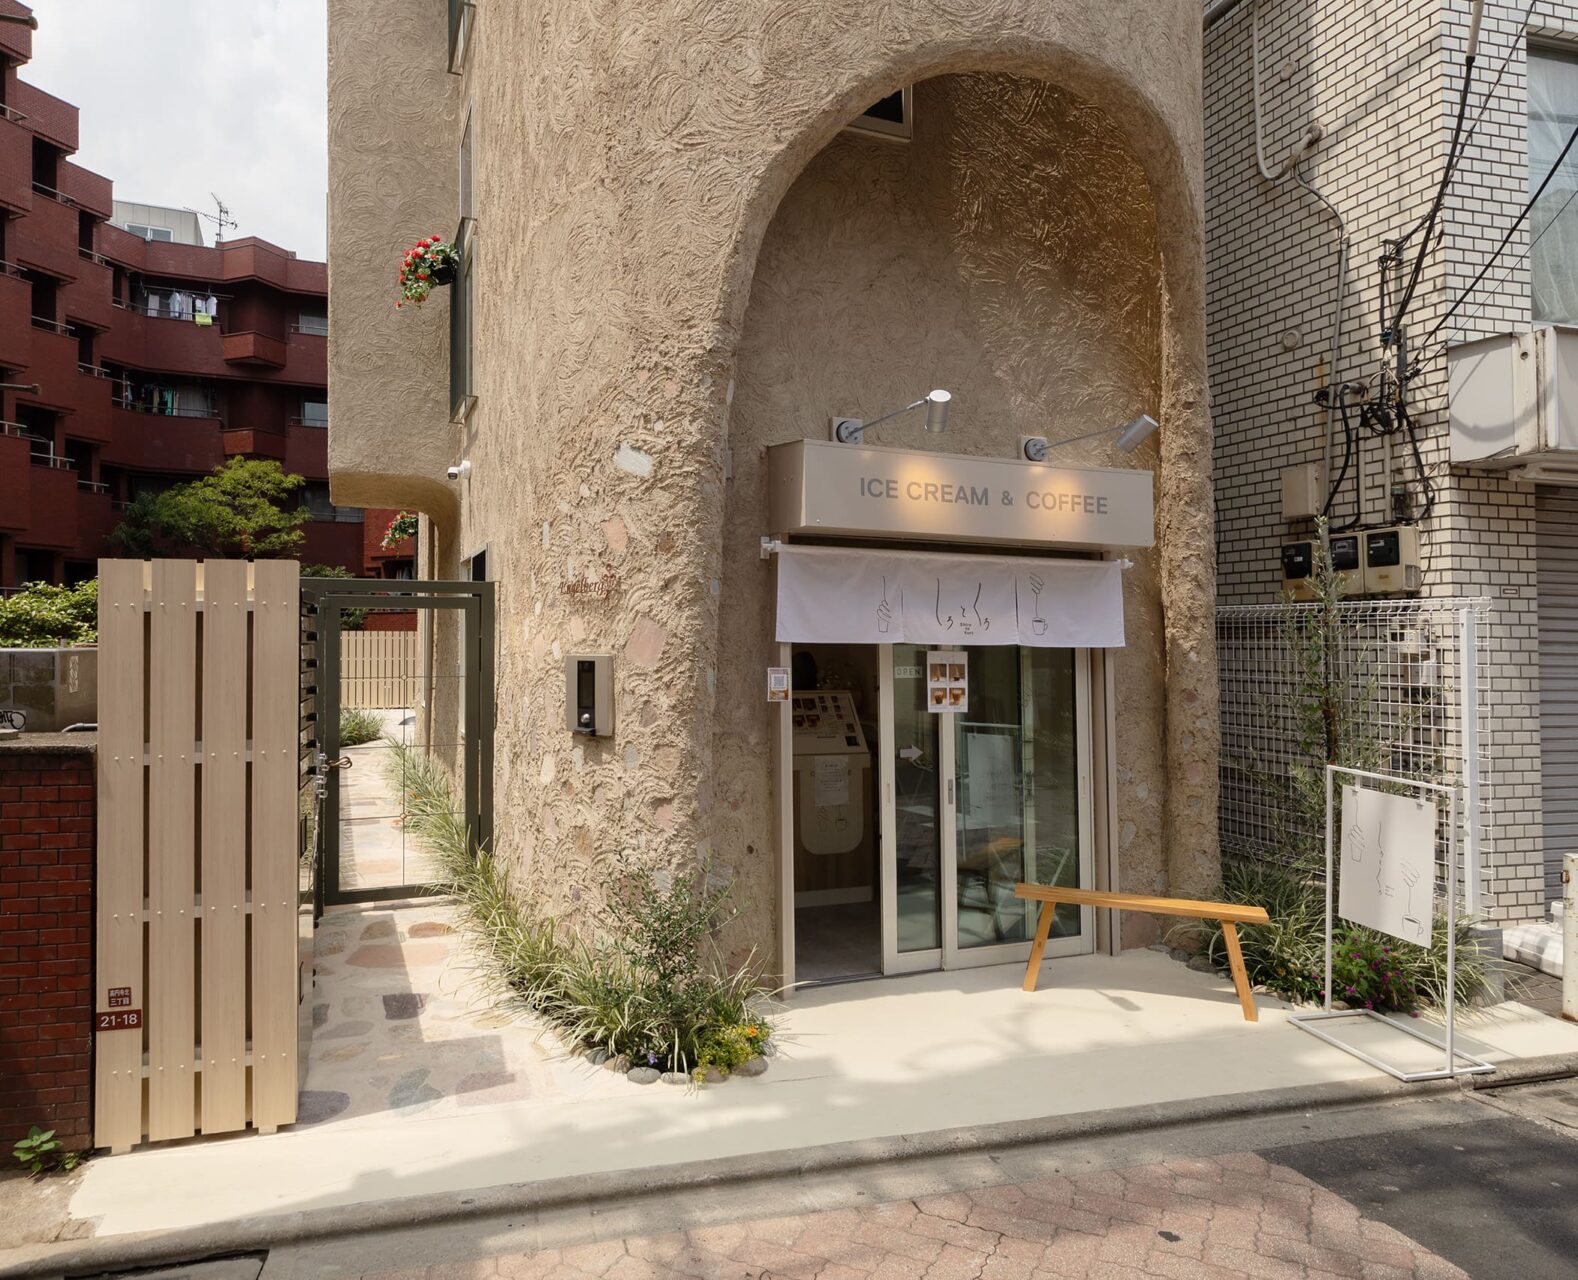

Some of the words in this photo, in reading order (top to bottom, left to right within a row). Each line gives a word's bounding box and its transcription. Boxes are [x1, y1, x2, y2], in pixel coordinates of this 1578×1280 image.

[860, 477, 899, 499] ICE
[906, 481, 989, 506] CREAM
[1001, 490, 1014, 506] &
[1025, 490, 1108, 515] COFFEE
[896, 667, 920, 676] OPEN
[110, 998, 130, 1006] 三丁目
[100, 1013, 138, 1027] 21-18
